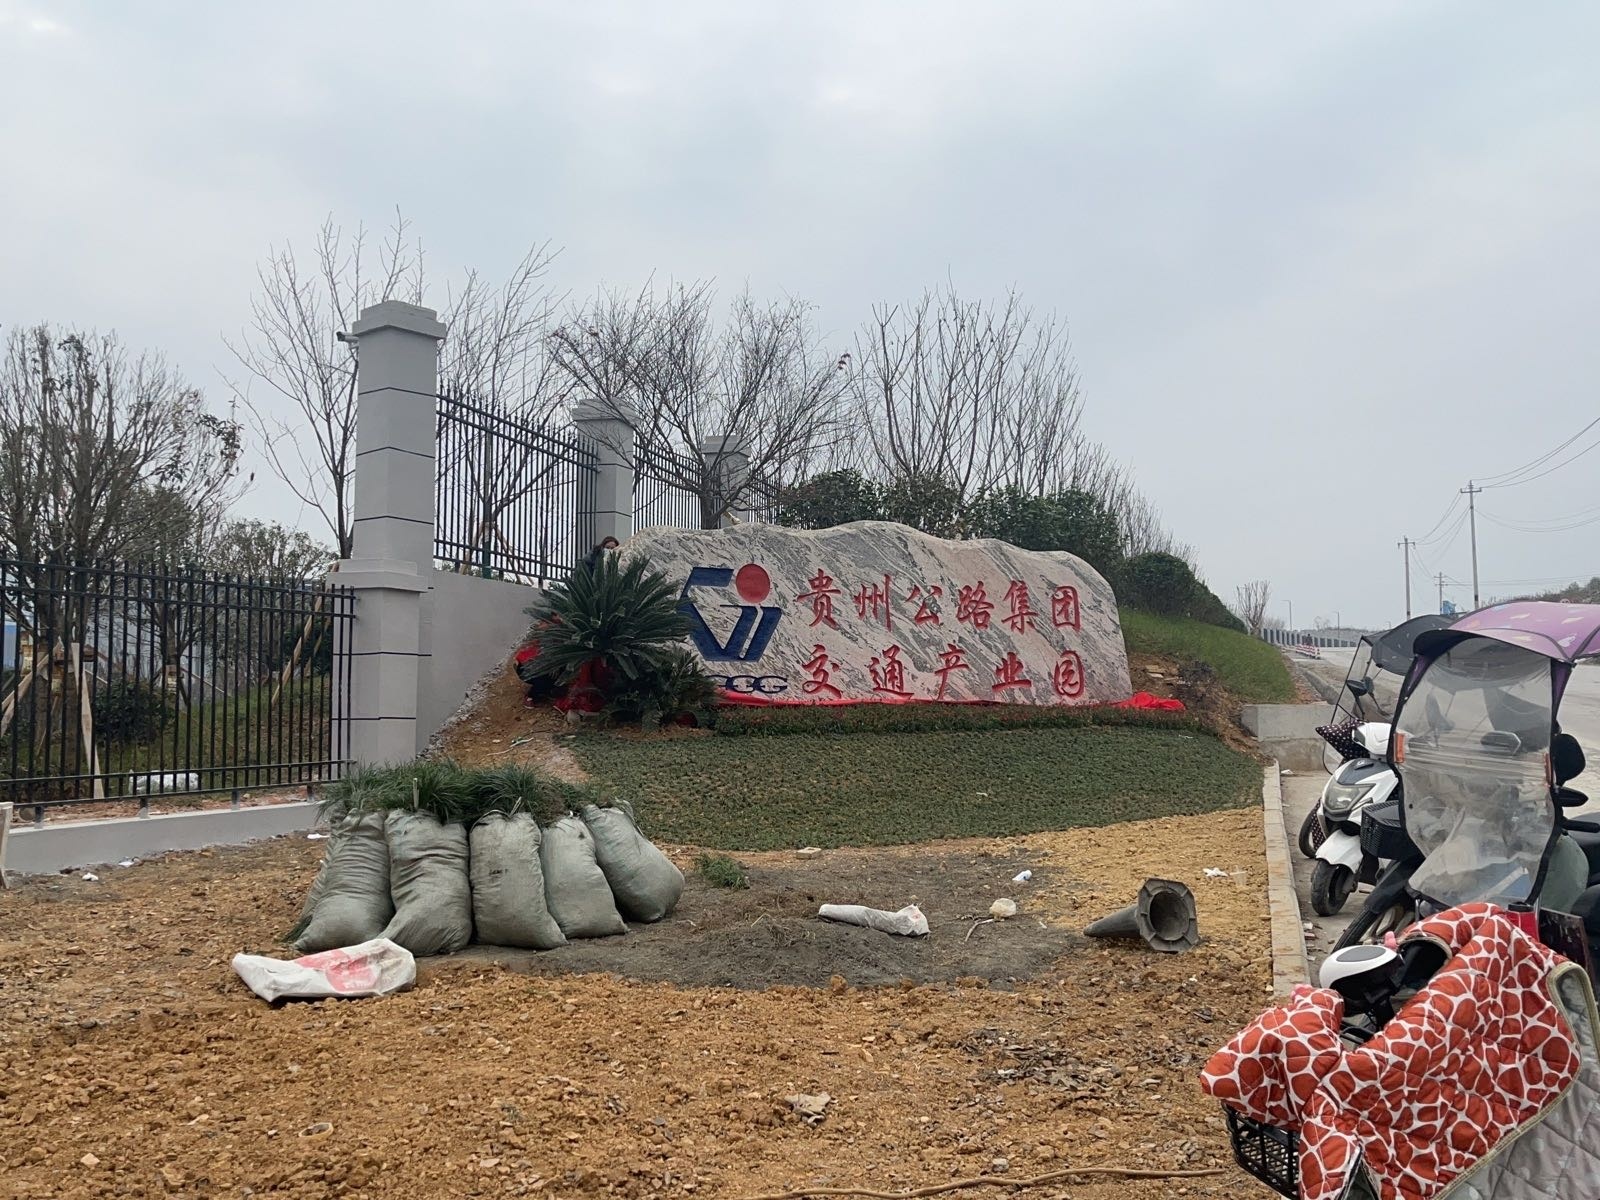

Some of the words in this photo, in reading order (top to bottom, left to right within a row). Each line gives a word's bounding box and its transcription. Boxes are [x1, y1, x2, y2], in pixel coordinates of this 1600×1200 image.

[797, 568, 1081, 634] 贵州公路集团
[801, 643, 1085, 699] 交通产业园
